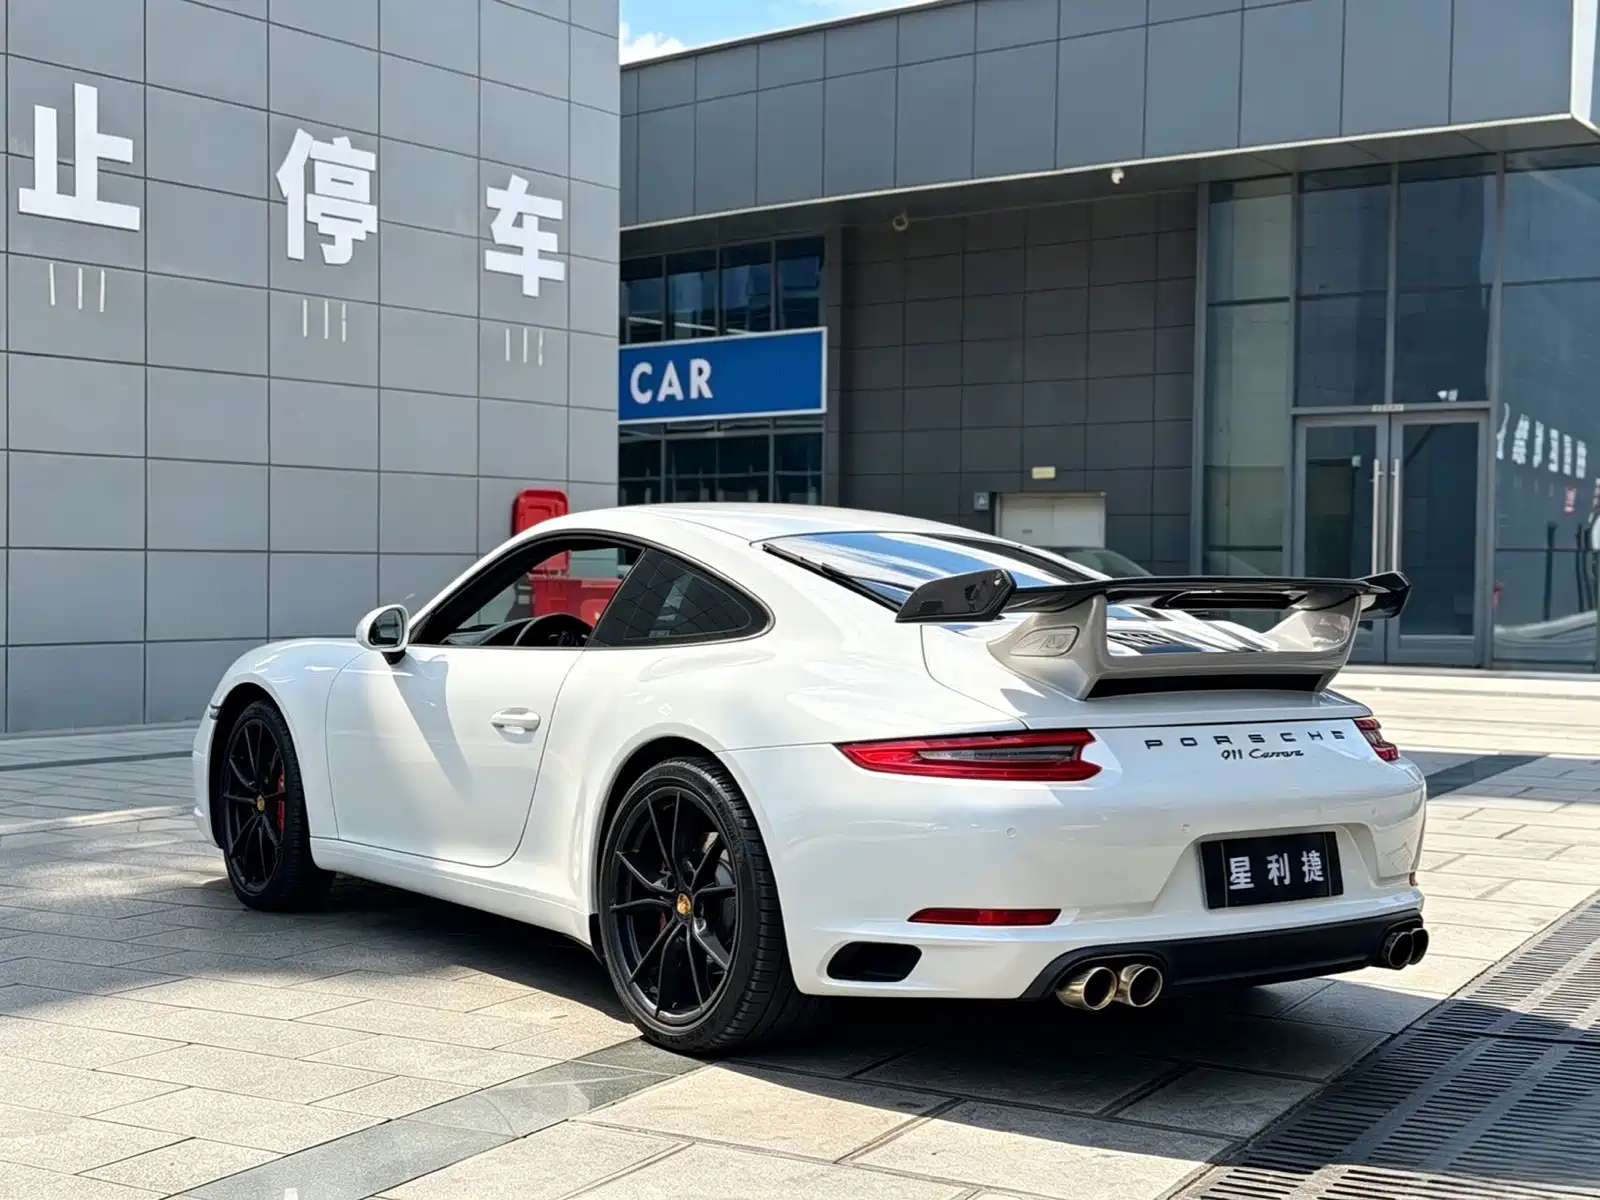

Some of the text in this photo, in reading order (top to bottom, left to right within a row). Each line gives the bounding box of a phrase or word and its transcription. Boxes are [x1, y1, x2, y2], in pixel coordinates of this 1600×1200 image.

[629, 357, 713, 404] CAR
[1144, 730, 1346, 750] PORSCHE
[1221, 748, 1305, 760] 911 Carrera
[1229, 849, 1325, 890] 星利捷
